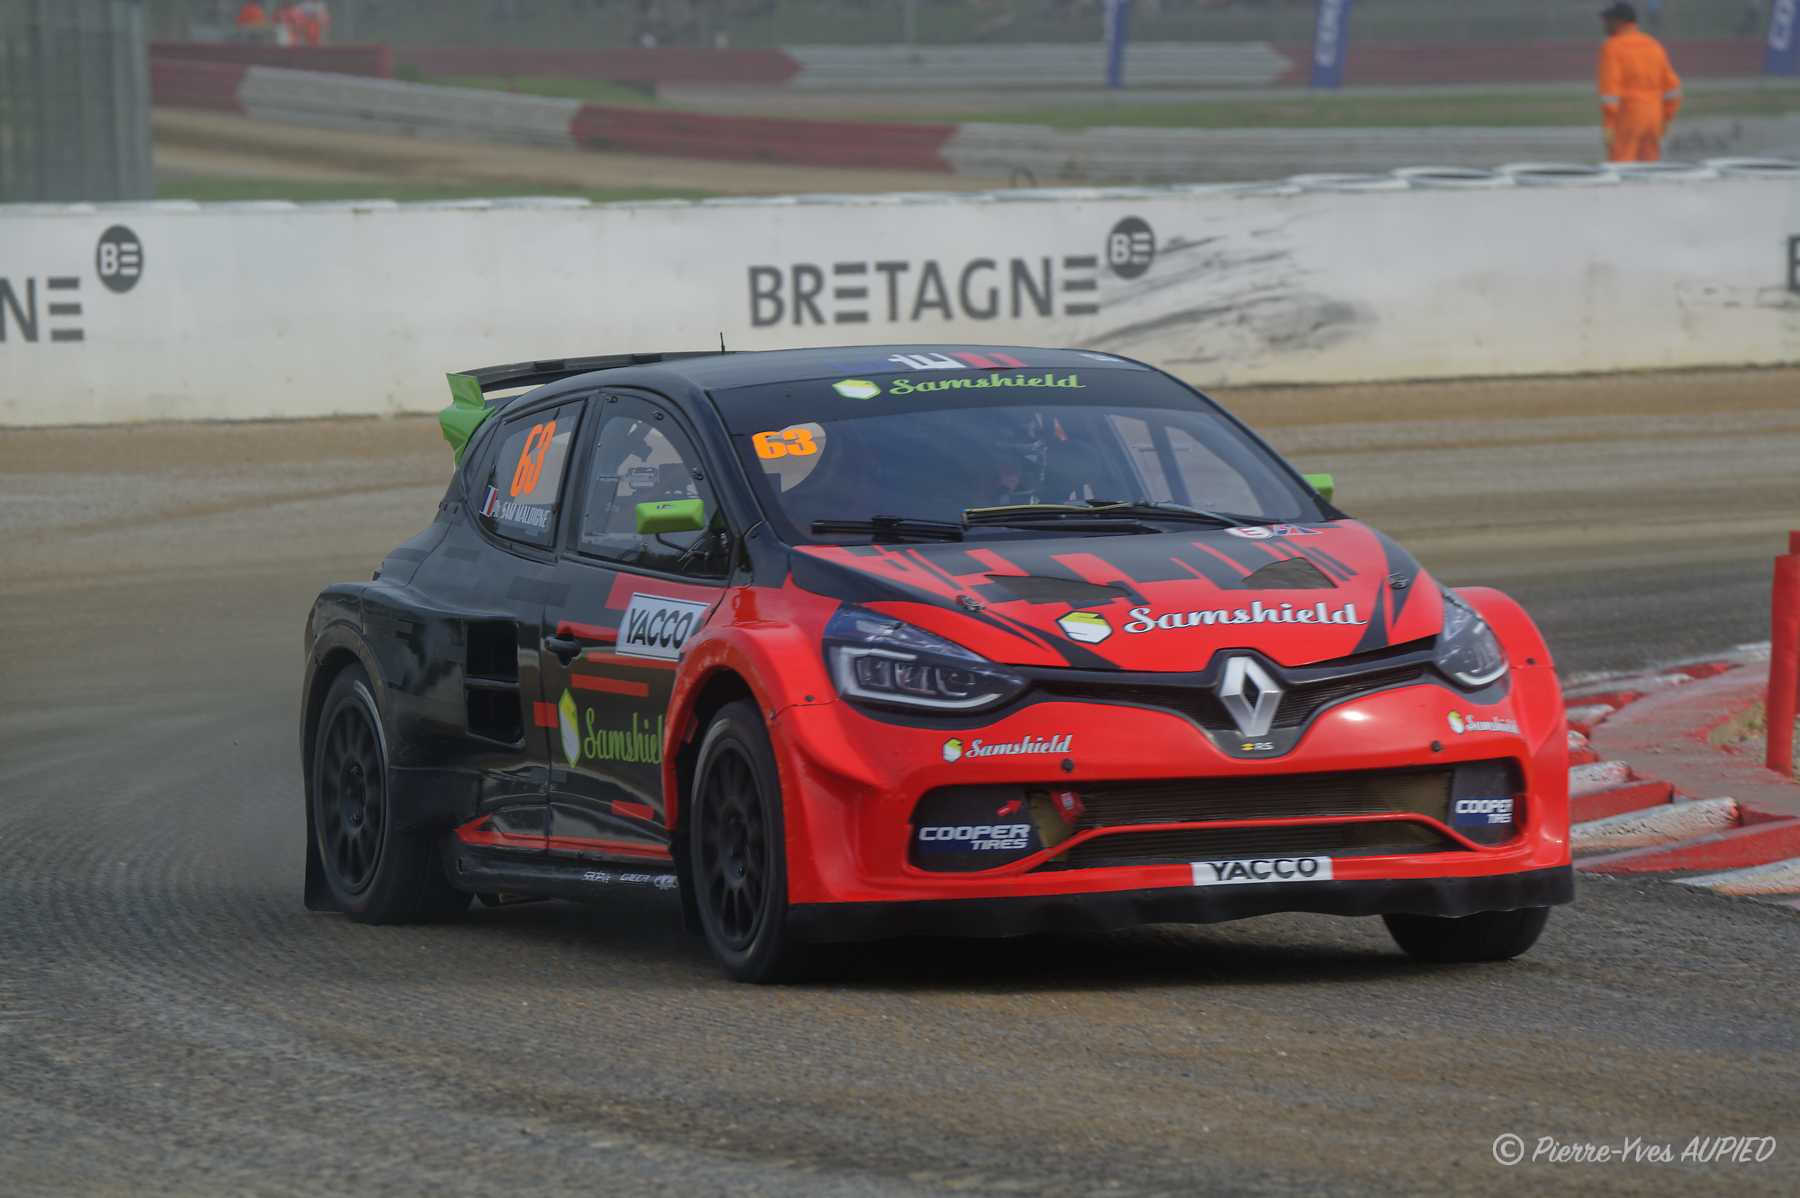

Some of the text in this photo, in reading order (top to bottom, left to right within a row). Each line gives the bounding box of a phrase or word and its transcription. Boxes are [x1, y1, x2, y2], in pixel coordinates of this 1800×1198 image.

[748, 256, 1099, 328] BRETAGNE
[888, 373, 1087, 396] Samshield
[752, 427, 817, 460] 63
[510, 420, 557, 497] 63
[626, 608, 694, 650] YACCO
[1123, 600, 1368, 634] Samshield
[584, 707, 664, 765] Samshiel
[965, 734, 1073, 759] Samshield
[1254, 741, 1275, 751] RS
[918, 823, 1031, 841] COOPER
[970, 838, 1029, 851] TIRES
[1206, 857, 1319, 882] YACCO
